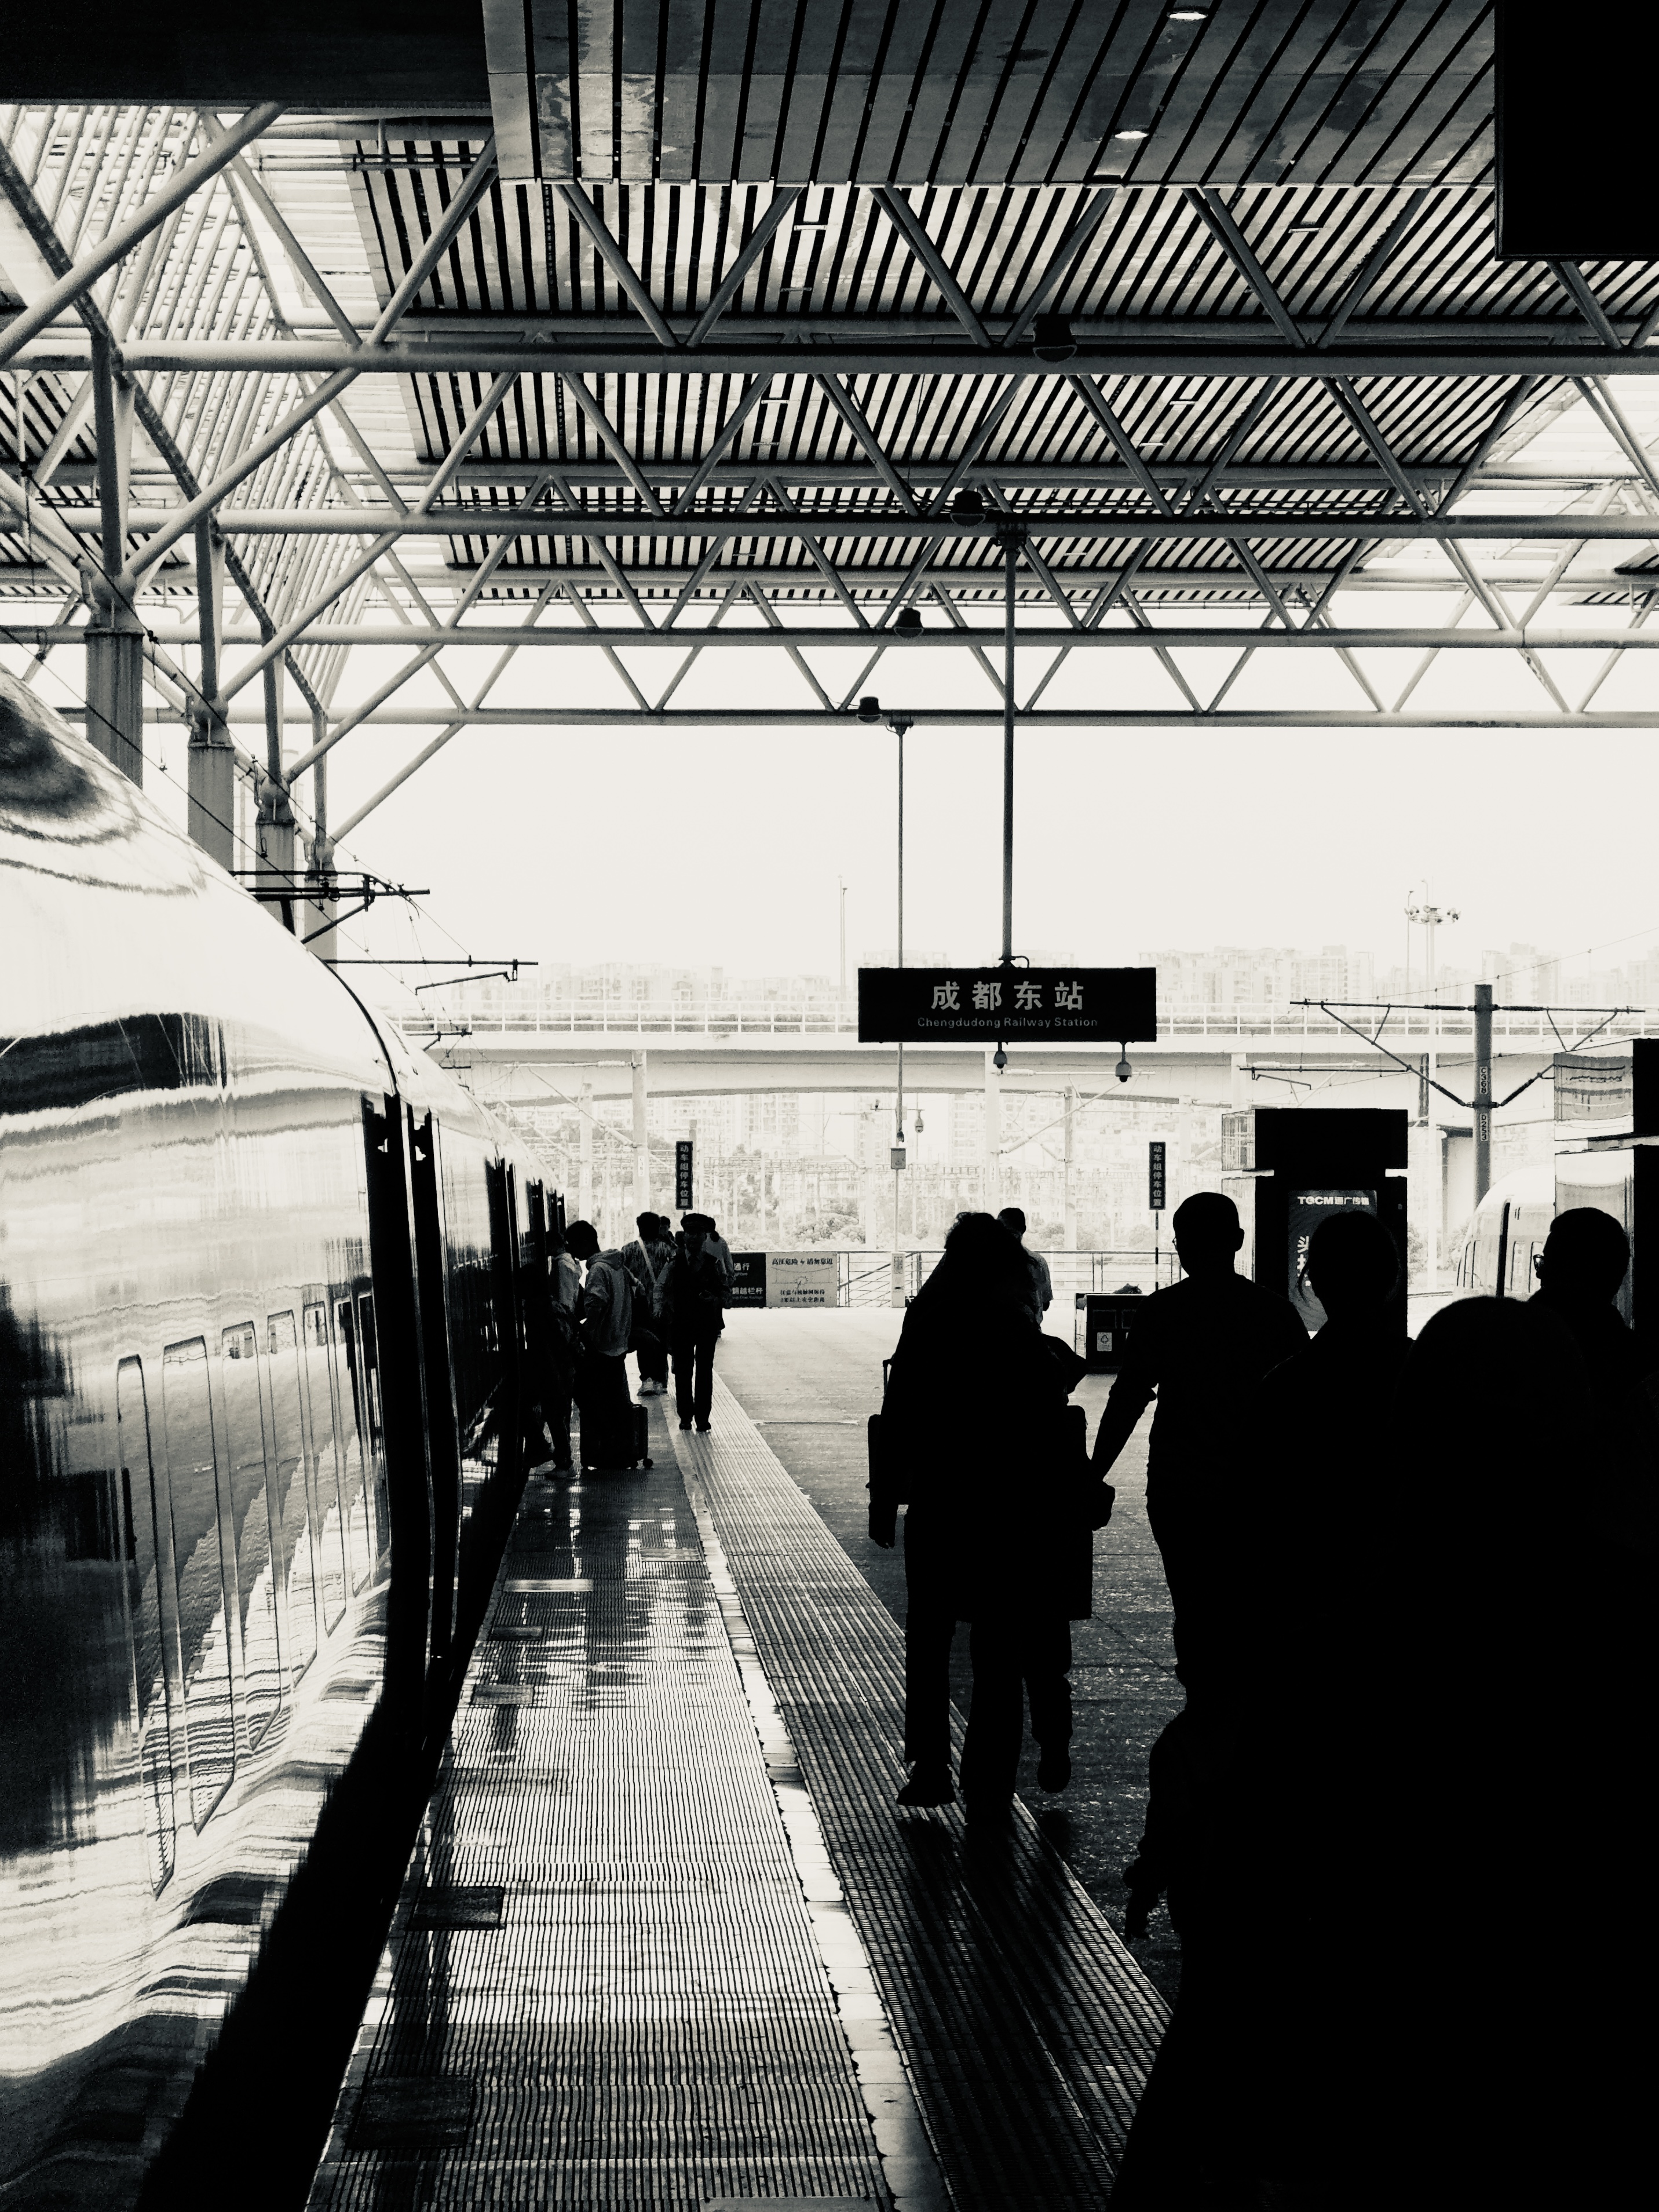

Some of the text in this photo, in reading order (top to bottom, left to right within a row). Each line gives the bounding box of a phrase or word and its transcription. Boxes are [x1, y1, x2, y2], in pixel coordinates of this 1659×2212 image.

[931, 980, 1084, 1011] 成都东站
[918, 1017, 1098, 1029] Chengdudong Railway Station
[679, 1145, 689, 1206] 动车组停车位置
[1153, 1145, 1163, 1206] 动车组停车位置
[1298, 1196, 1333, 1205] TGCM
